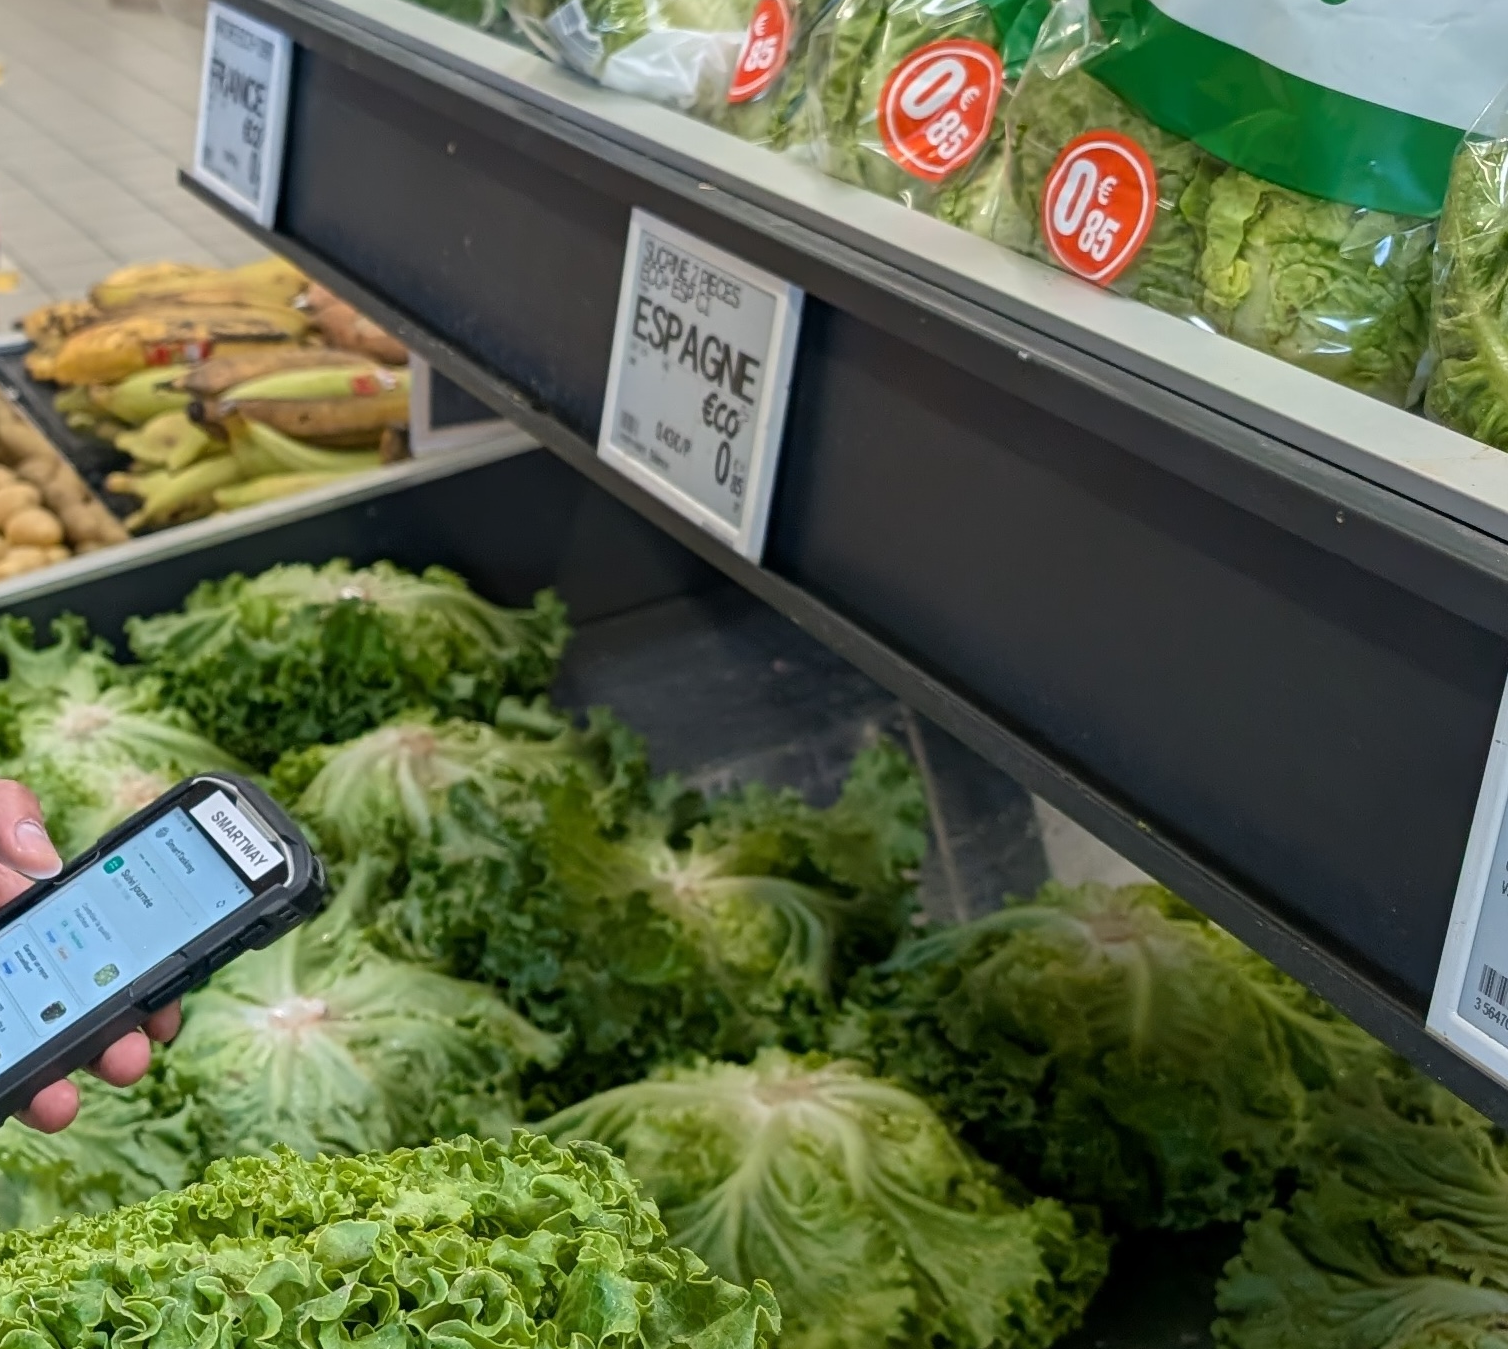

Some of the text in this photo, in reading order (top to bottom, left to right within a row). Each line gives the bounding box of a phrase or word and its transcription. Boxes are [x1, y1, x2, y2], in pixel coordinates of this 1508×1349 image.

[631, 295, 760, 406] ESPAGNE
[165, 838, 196, 875] SmartTasking
[211, 810, 269, 868] SMARTWAY
[120, 869, 138, 886] Suivi
[129, 883, 155, 910] journée
